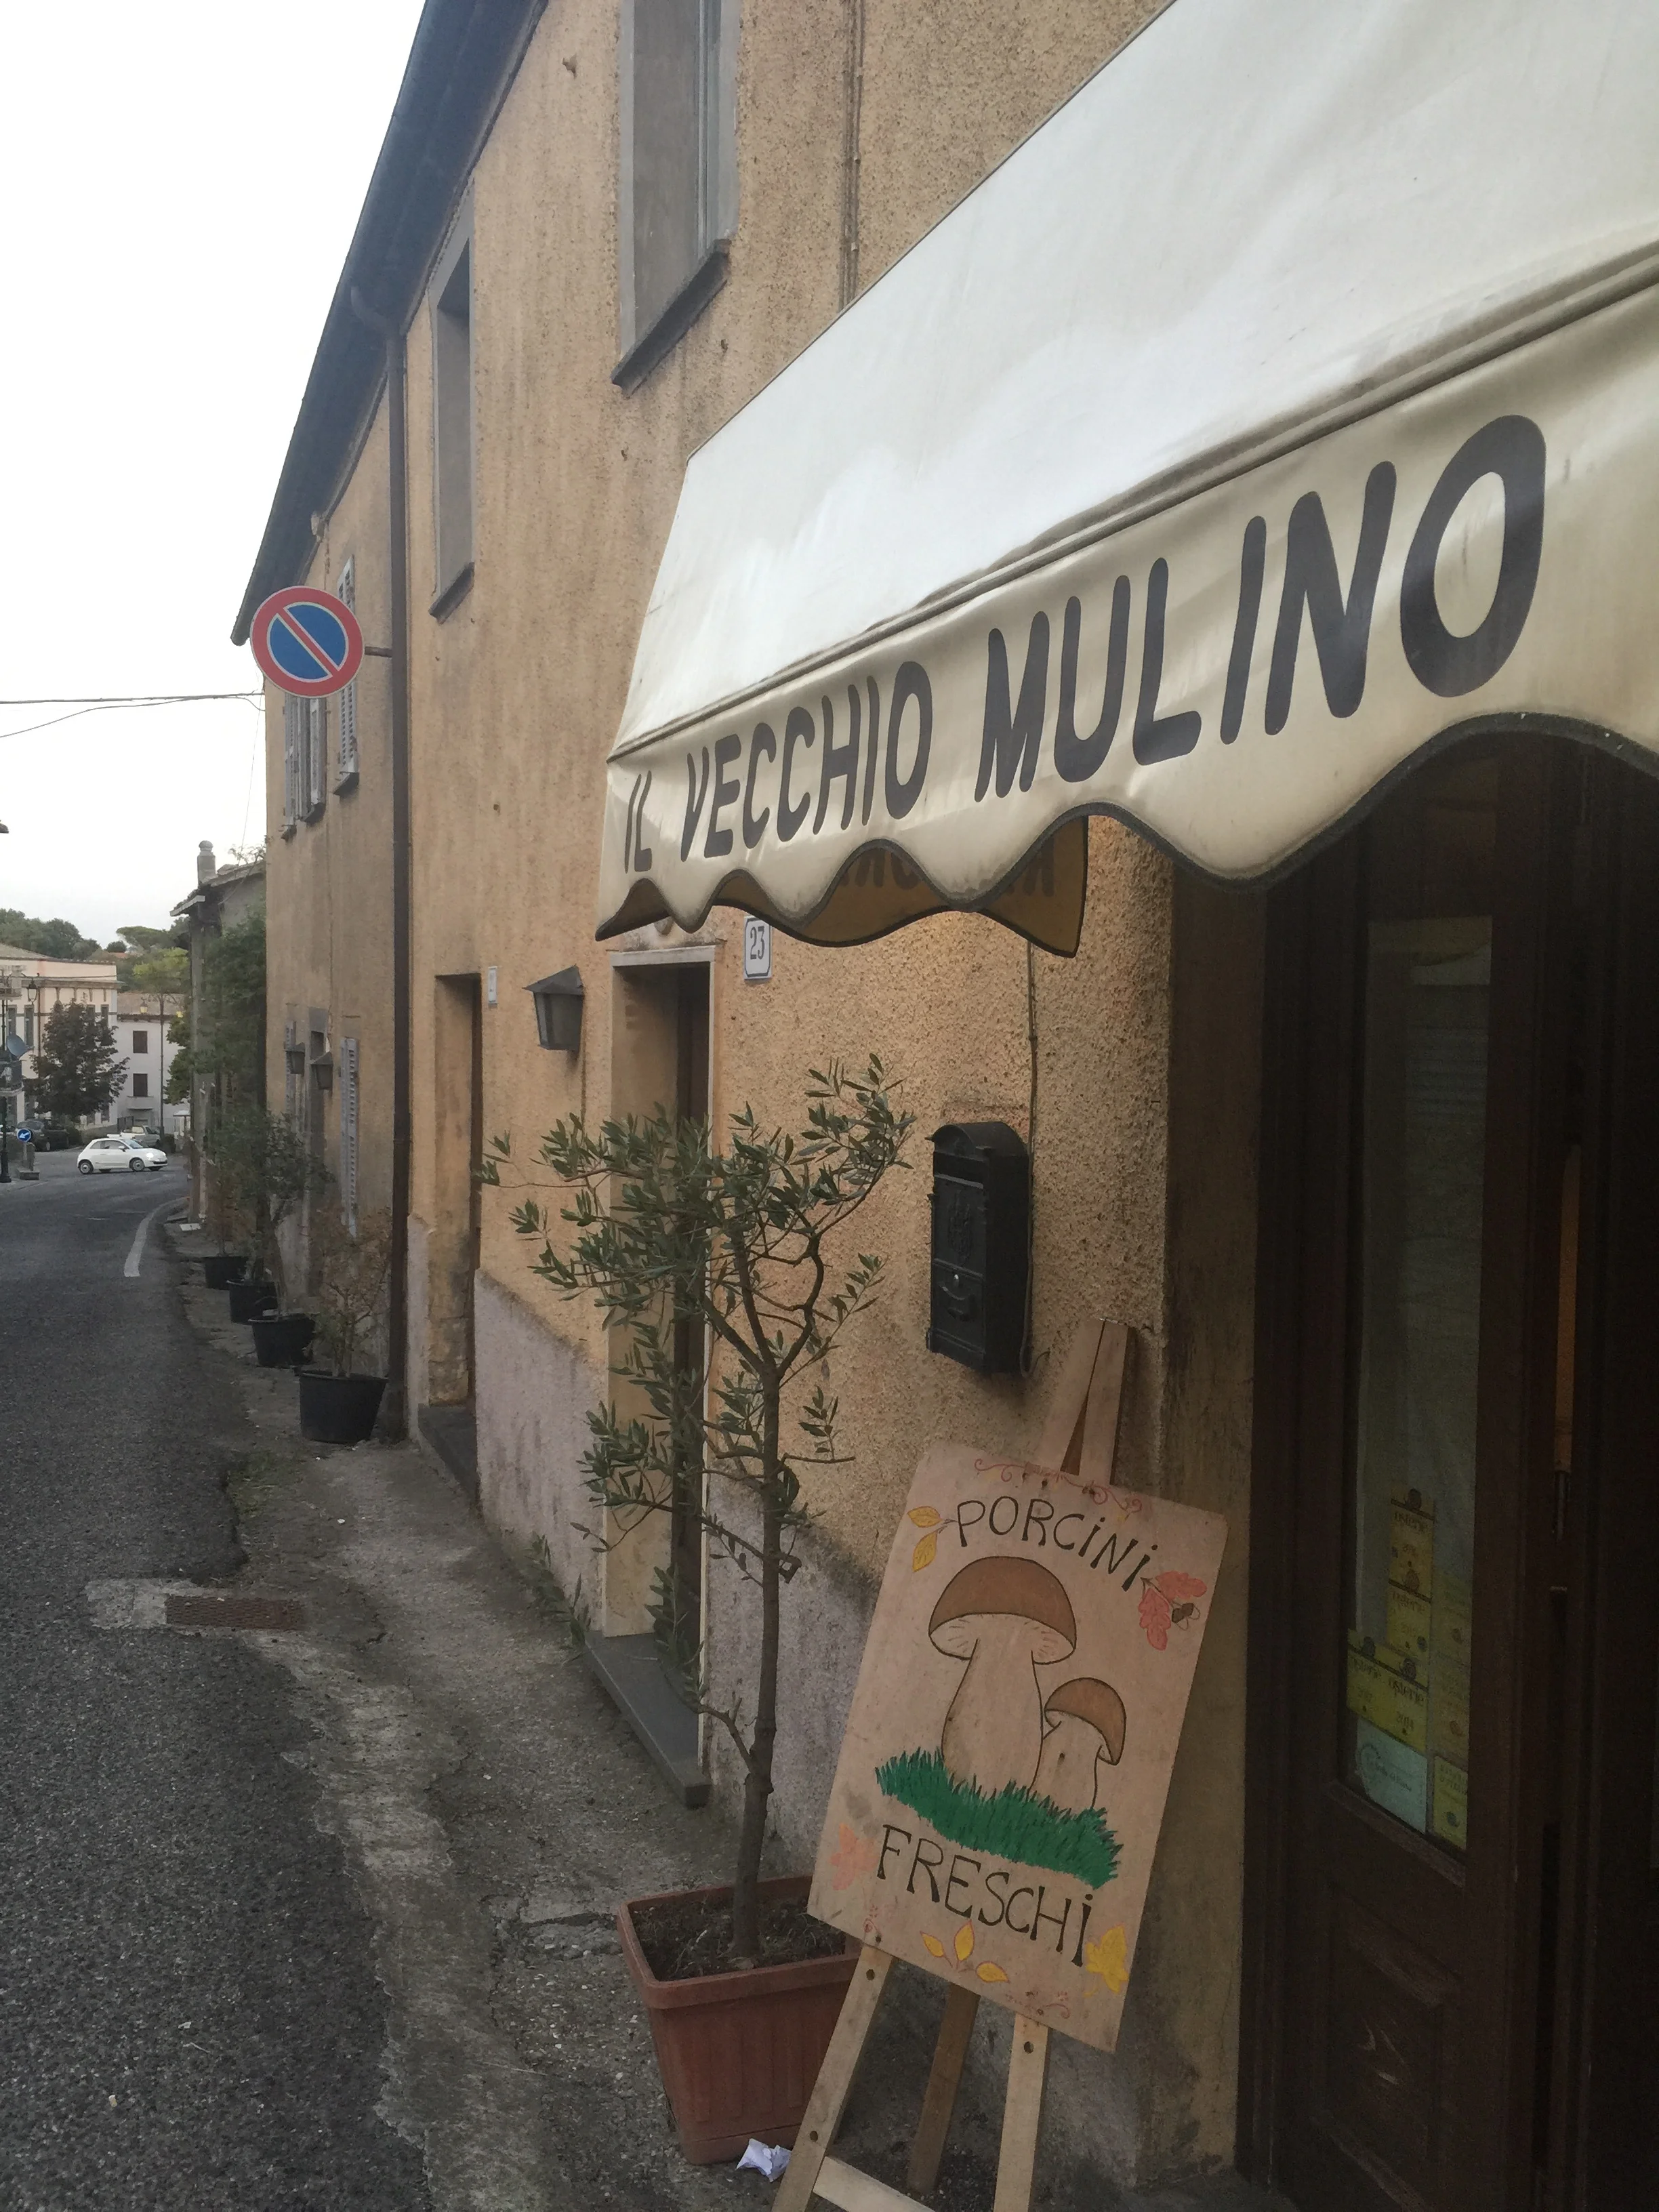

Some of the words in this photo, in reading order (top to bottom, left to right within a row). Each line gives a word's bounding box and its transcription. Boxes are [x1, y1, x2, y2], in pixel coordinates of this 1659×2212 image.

[625, 771, 653, 874] IL
[680, 661, 933, 862] VECCHIO
[975, 414, 1547, 803] MULINO
[750, 925, 765, 960] 23
